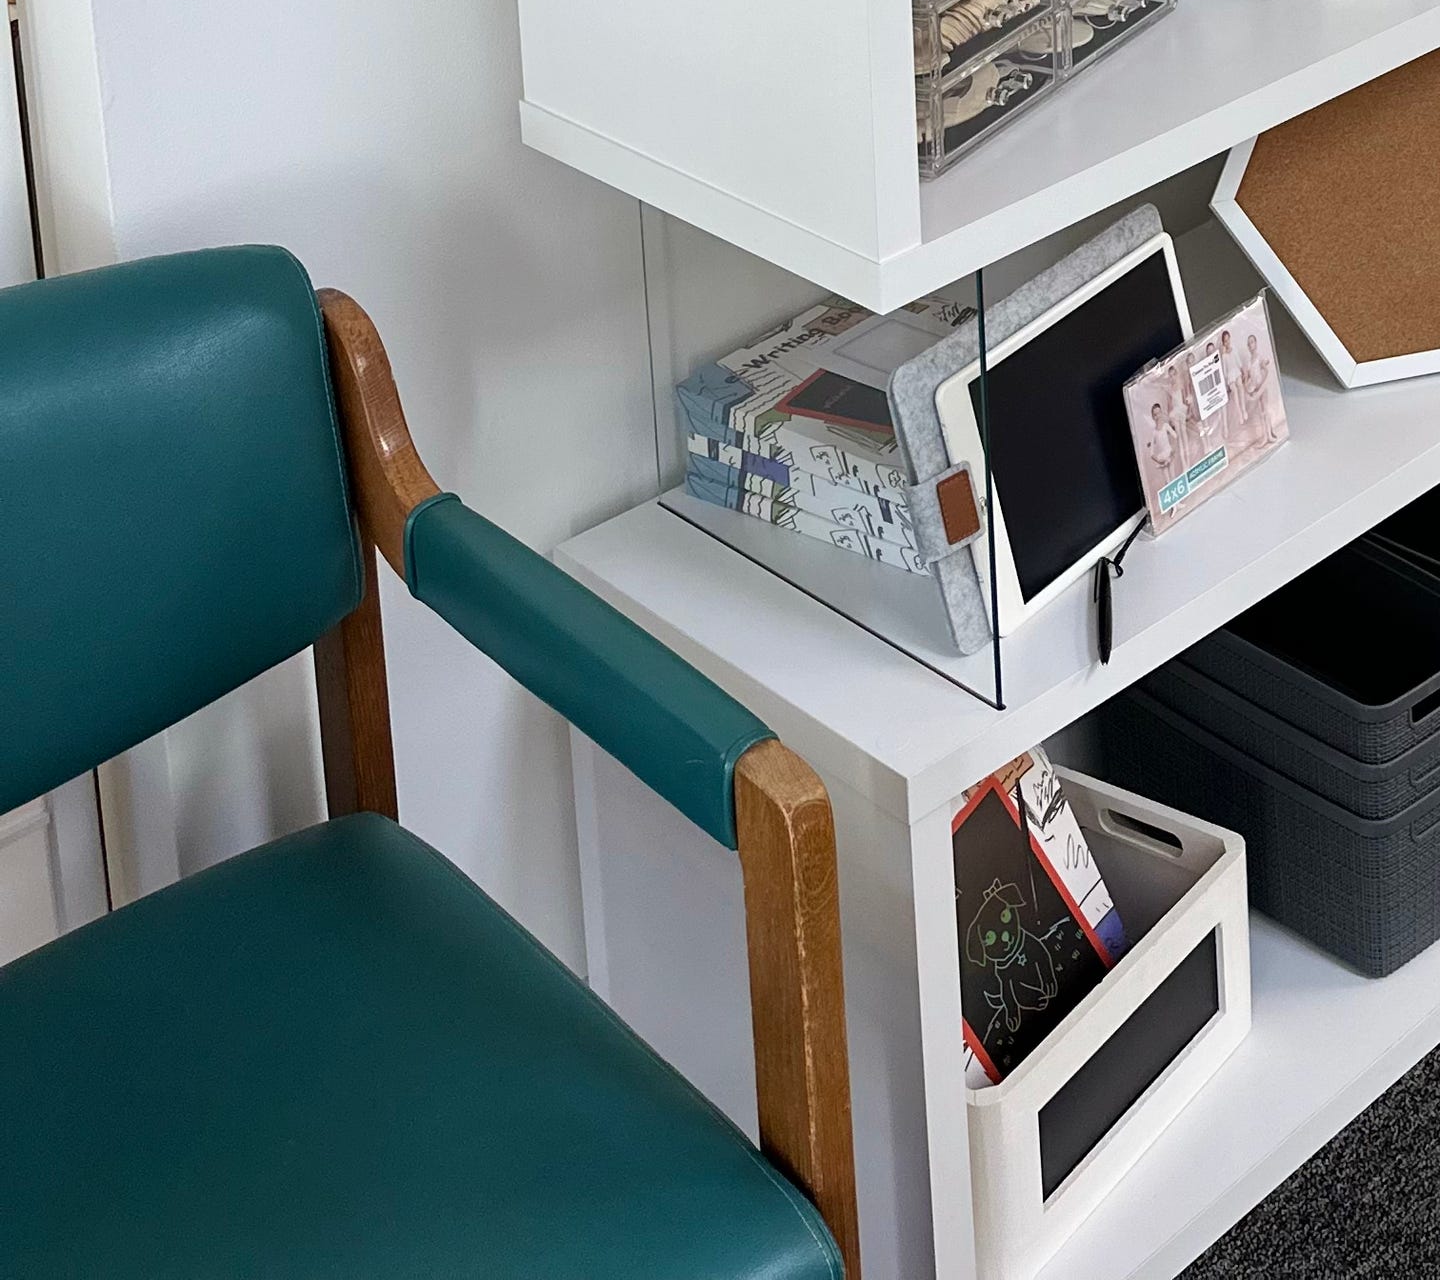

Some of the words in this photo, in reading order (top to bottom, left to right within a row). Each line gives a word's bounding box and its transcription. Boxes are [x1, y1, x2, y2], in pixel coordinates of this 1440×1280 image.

[742, 328, 825, 369] Writing
[822, 306, 861, 326] Boo
[1162, 480, 1186, 505] 4x6
